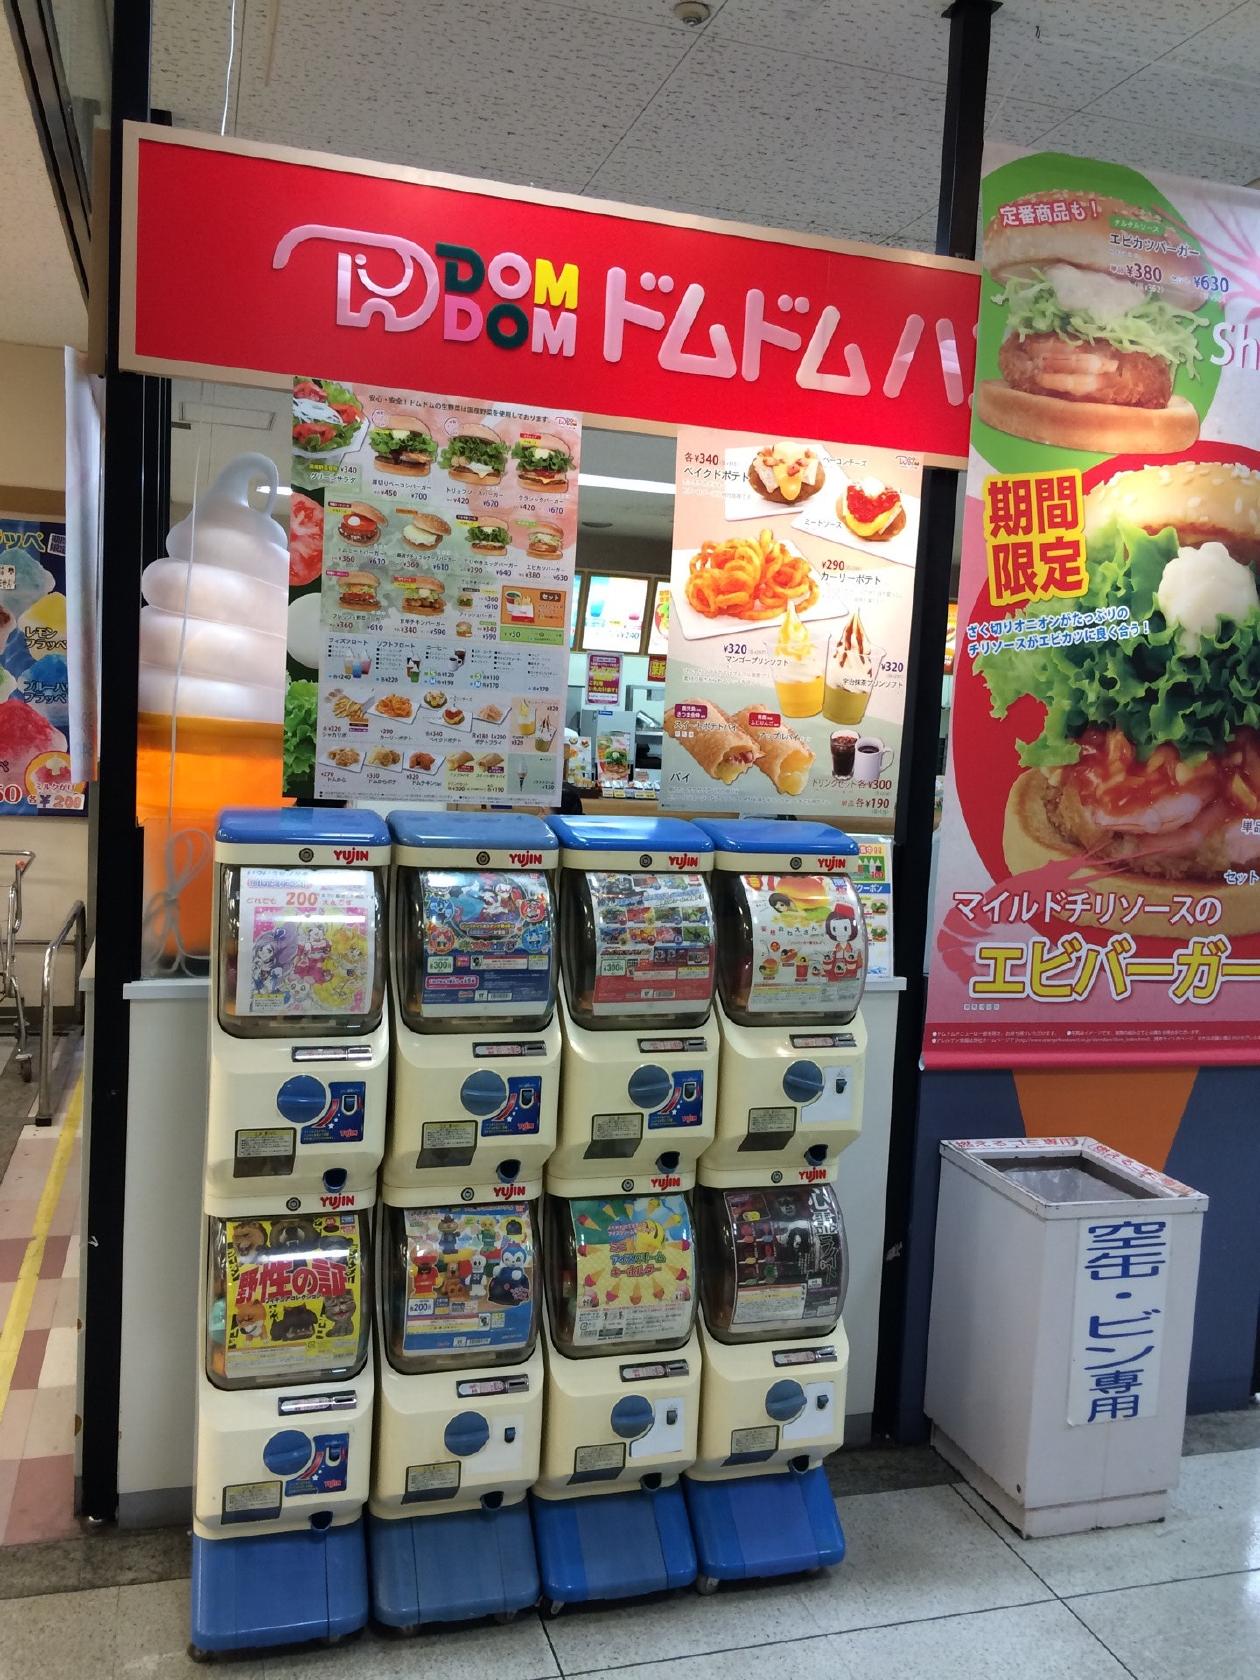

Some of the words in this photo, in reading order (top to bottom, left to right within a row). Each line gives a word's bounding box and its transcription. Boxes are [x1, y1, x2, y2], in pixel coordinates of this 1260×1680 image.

[999, 201, 1100, 227] 定番商品も!
[1109, 233, 1200, 257] エビカツバーガー
[436, 243, 579, 311] DOM
[1126, 263, 1162, 282] ¥380
[1194, 275, 1230, 293] ¥630
[444, 294, 577, 357] DOM
[603, 266, 977, 408] ドムドムハ
[684, 452, 719, 466] 各¥340
[683, 467, 750, 483] ベイクドポテト
[988, 475, 1079, 538] 期間
[821, 559, 845, 571] ¥290
[991, 536, 1085, 600] 限定
[820, 571, 881, 586] カーリーポテト
[967, 606, 1129, 639] ざく切りオニオンがたっぷりの
[25, 626, 58, 640] レモン
[968, 622, 1150, 657] チリソースがエビカツに良く合う!
[24, 638, 67, 651] フラッペ
[723, 643, 747, 656] ¥320
[725, 655, 790, 668] マンゴープリンソフト
[880, 661, 904, 673] ¥320
[24, 691, 67, 704] フラッペ
[856, 799, 890, 810] 各¥190
[1224, 870, 1260, 886] セット
[953, 891, 1222, 925] マイルドチリソースの
[970, 934, 1260, 1002] エビバーガー
[1084, 1220, 1167, 1423] 空缶・ビン専用
